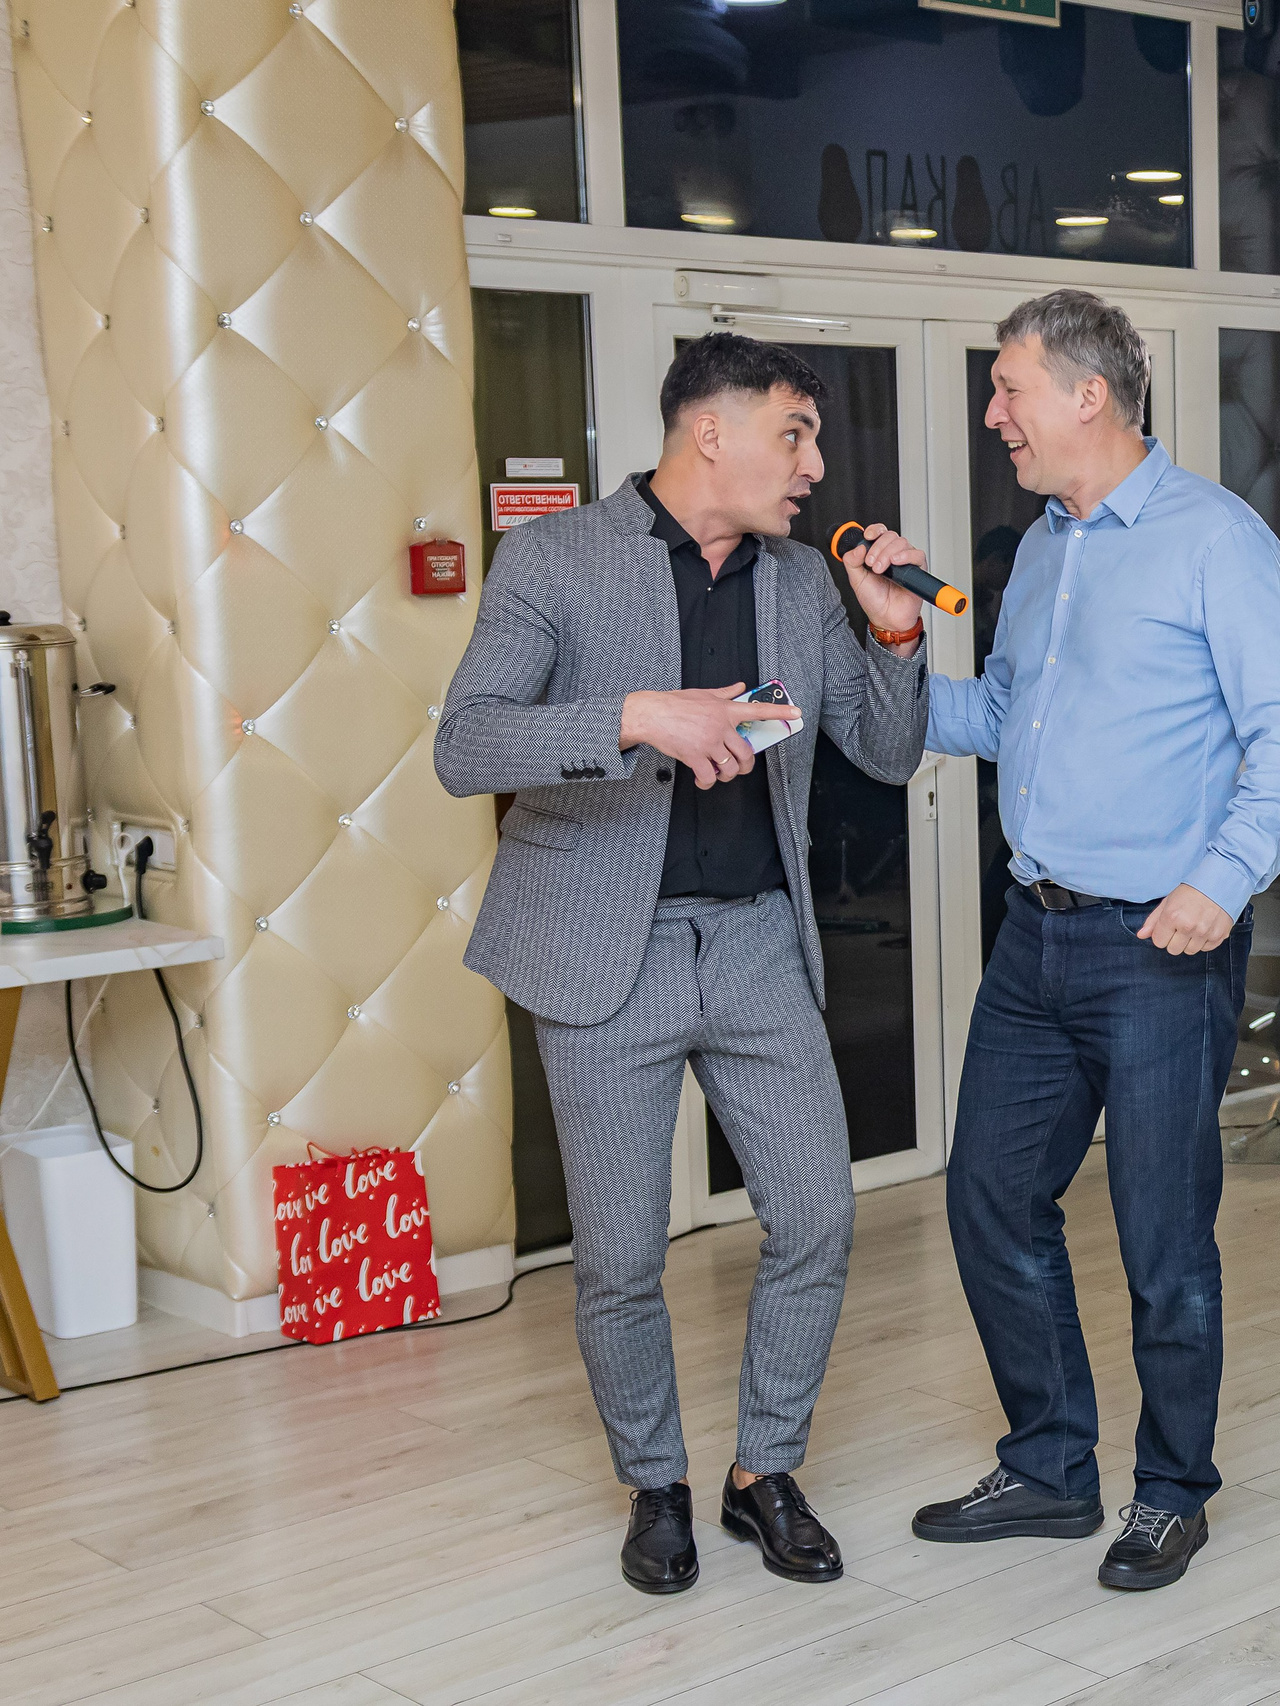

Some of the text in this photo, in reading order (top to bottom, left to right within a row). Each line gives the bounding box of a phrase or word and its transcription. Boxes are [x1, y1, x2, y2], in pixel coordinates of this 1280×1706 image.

[498, 493, 571, 505] ОТВЕТСТВЕННЫЙ
[342, 1160, 397, 1199] love
[383, 1193, 430, 1239] lov
[316, 1217, 369, 1264] love
[356, 1256, 413, 1302] love
